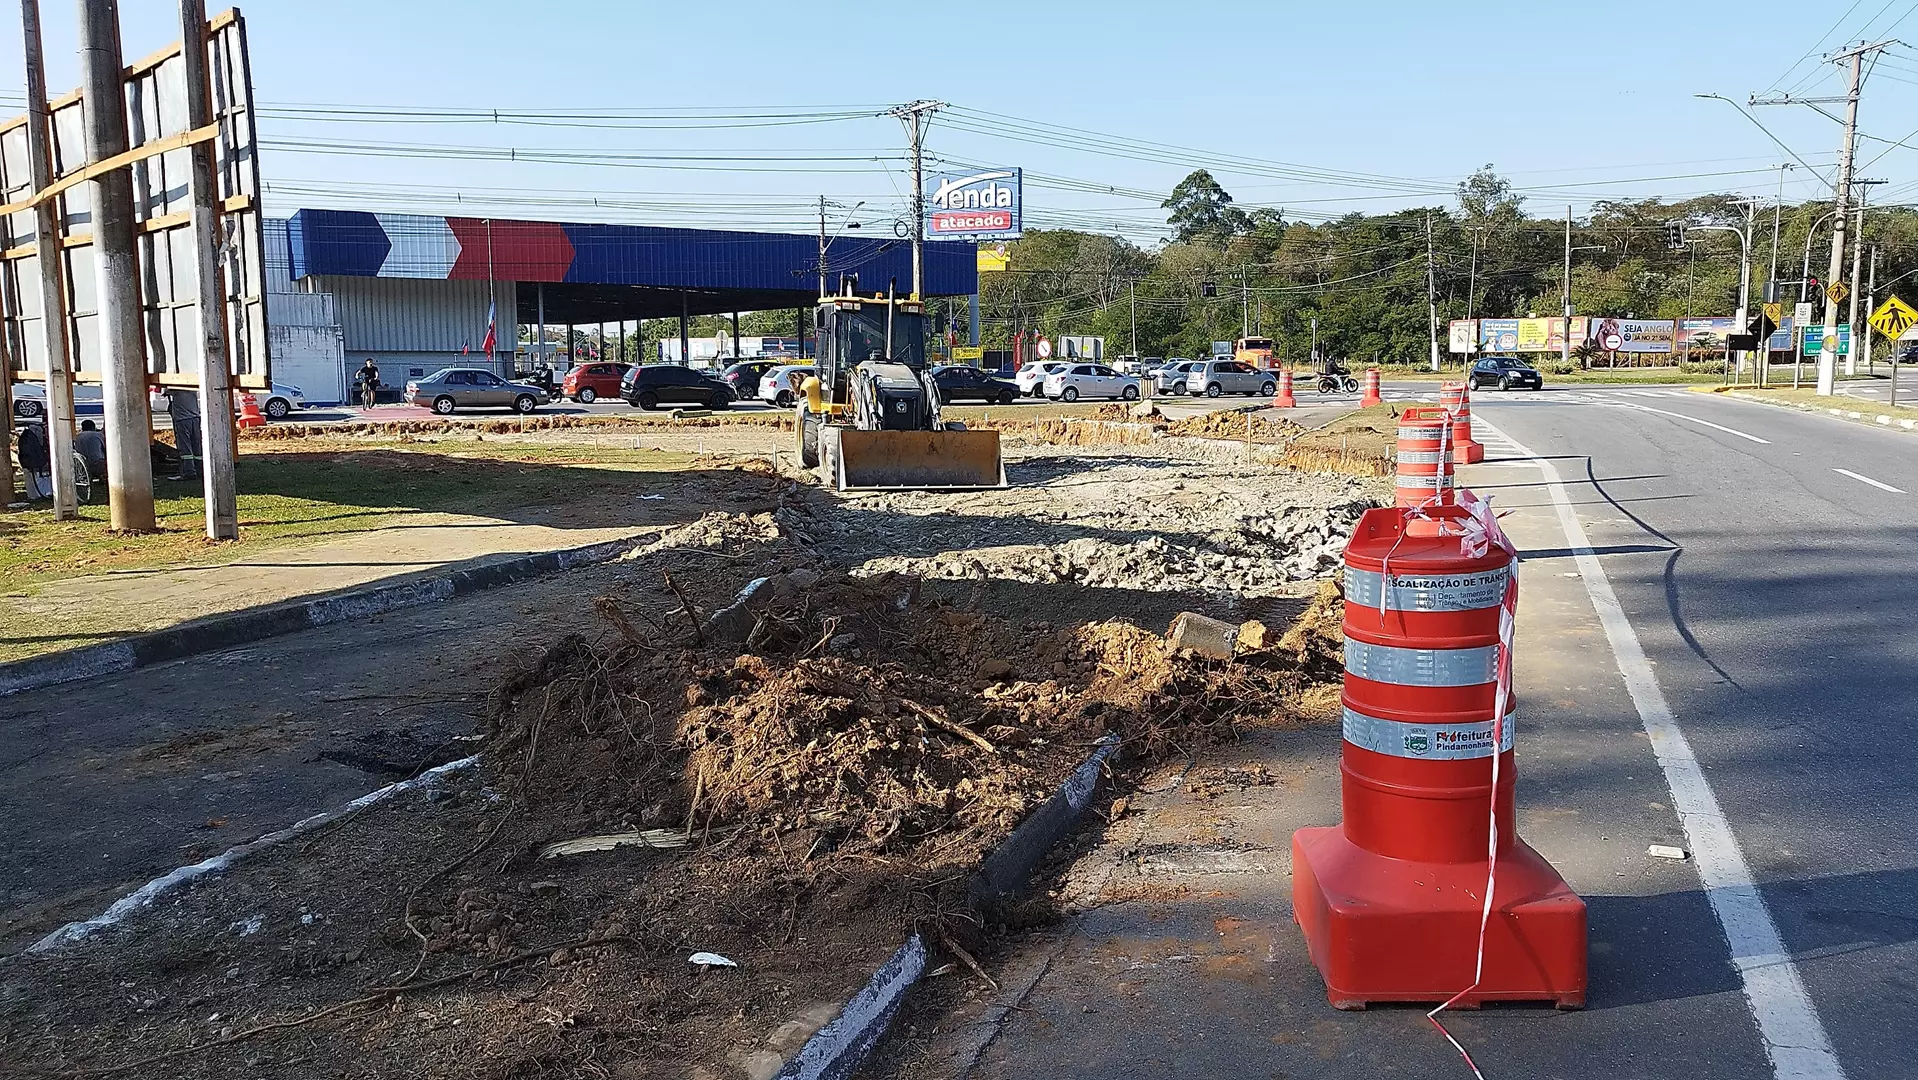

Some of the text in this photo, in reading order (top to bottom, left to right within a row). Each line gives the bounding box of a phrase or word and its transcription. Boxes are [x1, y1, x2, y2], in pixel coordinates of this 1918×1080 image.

[940, 215, 1004, 228] atacado
[1624, 324, 1672, 333] SEJA ANGLO
[1389, 570, 1510, 588] ISCALIZAÇÃO DE TRÂNSIT
[1436, 741, 1494, 751] Pindamonhang
